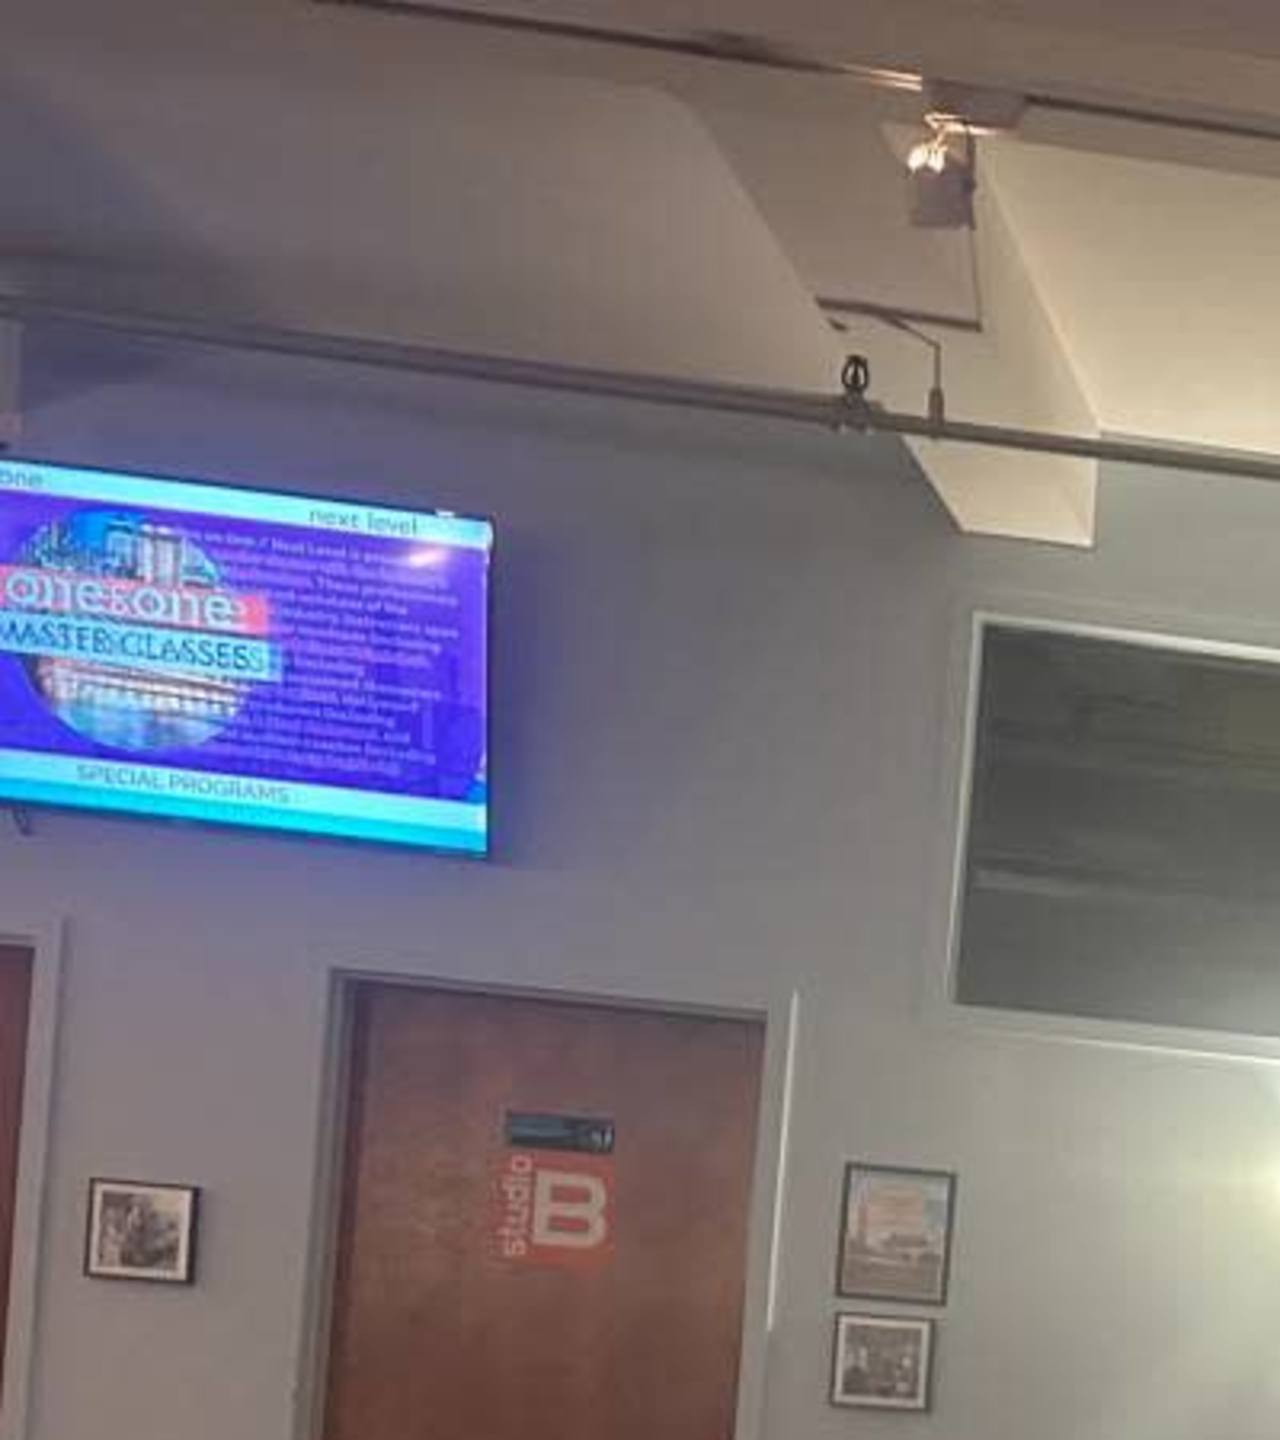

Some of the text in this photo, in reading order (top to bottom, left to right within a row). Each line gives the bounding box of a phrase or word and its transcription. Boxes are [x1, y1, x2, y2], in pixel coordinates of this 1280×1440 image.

[309, 510, 418, 535] next level
[6, 569, 108, 613] one
[133, 585, 238, 629] one
[77, 763, 291, 804] SPECIAL PROGRAMS
[531, 1169, 607, 1248] B
